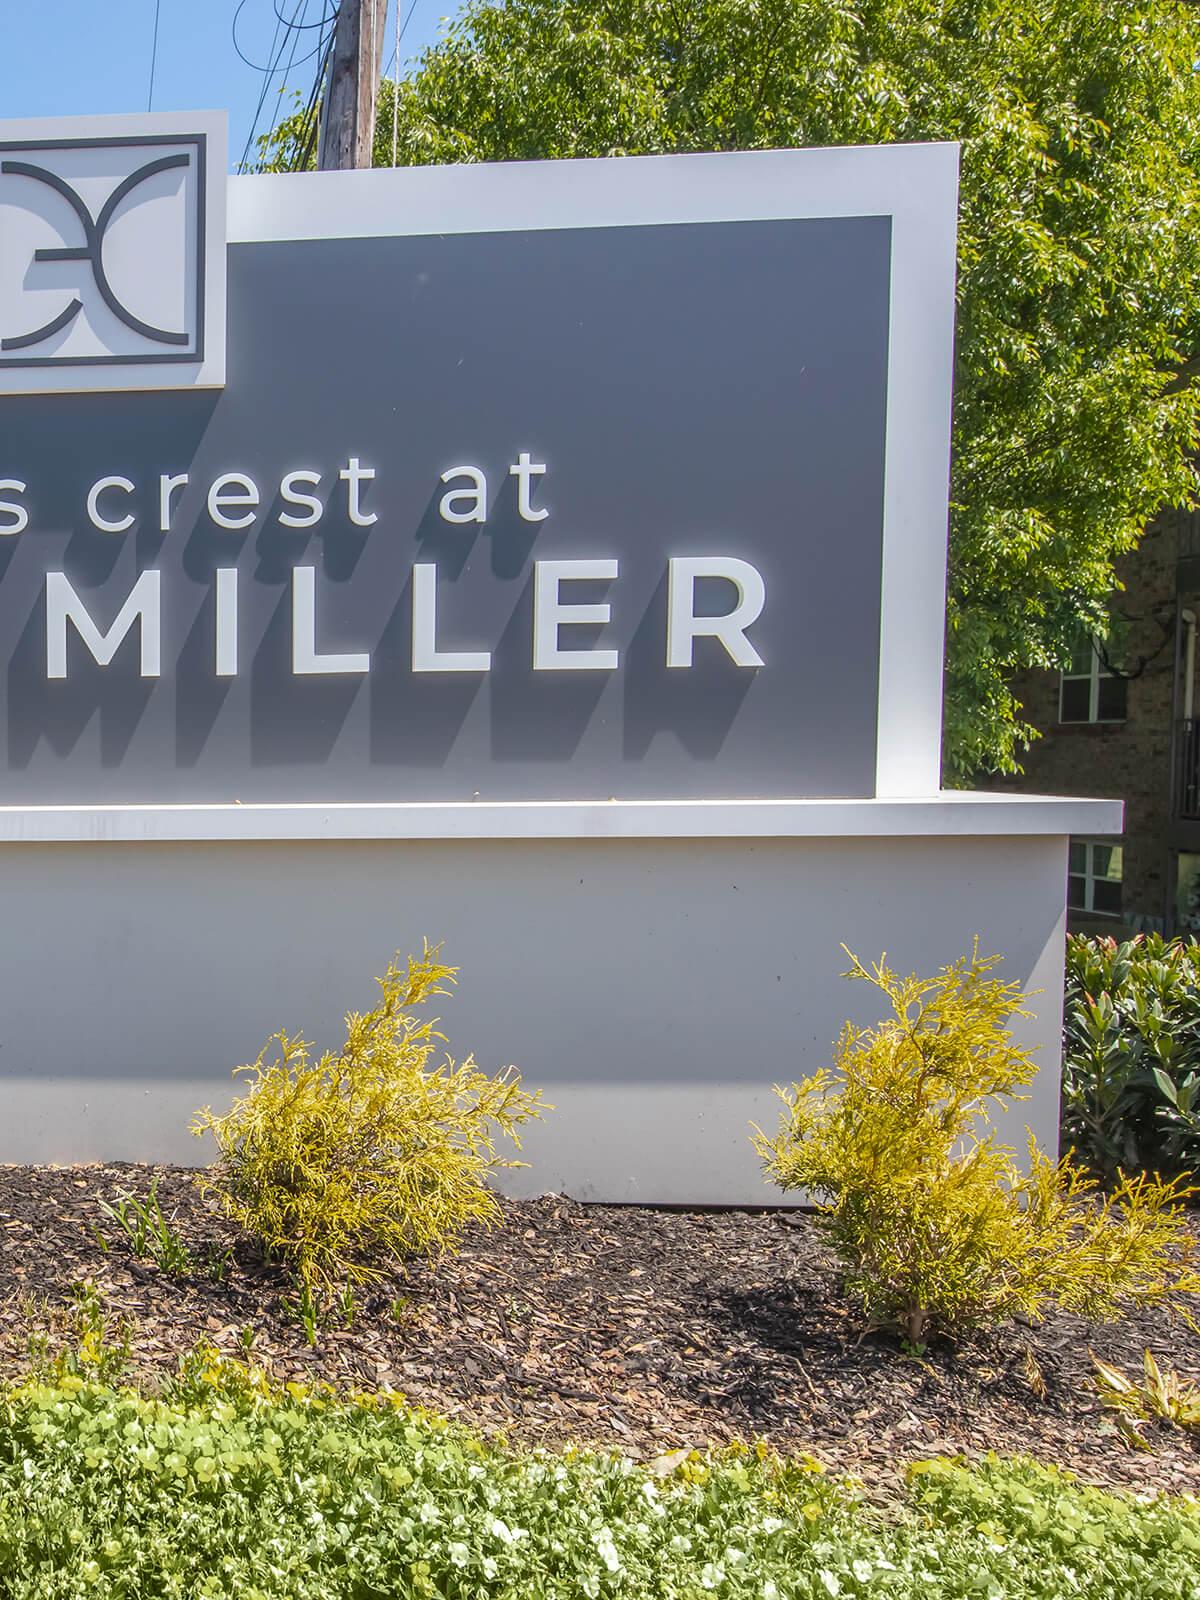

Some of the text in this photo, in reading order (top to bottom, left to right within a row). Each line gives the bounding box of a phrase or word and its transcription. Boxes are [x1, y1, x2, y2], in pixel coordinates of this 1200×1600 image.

[88, 458, 377, 531] crest
[440, 453, 549, 522] at
[47, 557, 765, 678] MILLER
